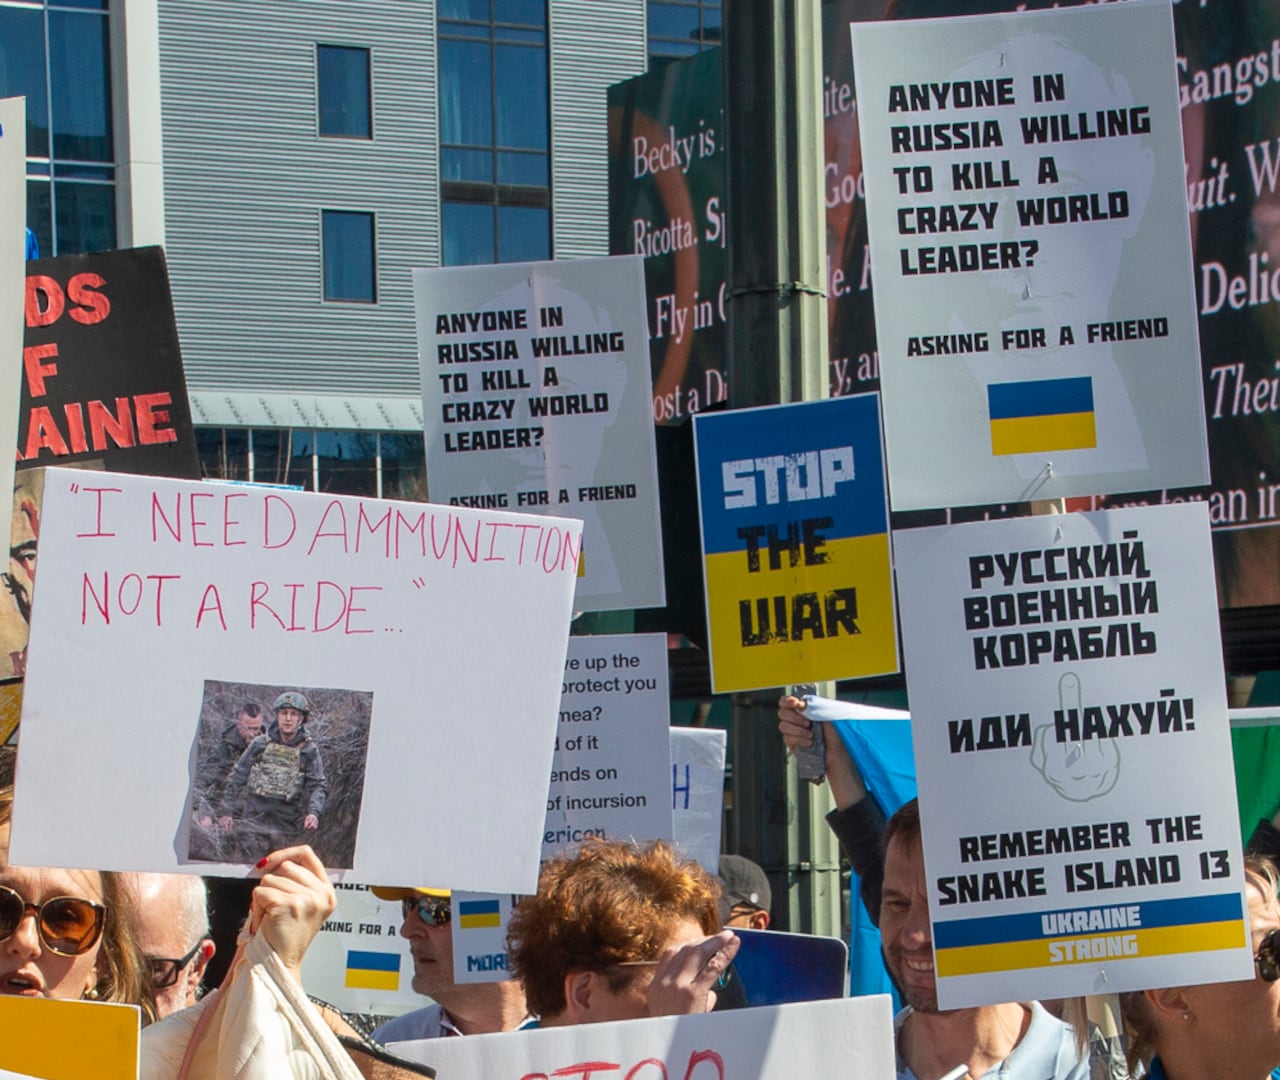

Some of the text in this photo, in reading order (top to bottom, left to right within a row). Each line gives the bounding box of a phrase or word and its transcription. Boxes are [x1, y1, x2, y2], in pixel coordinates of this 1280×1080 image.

[888, 77, 1015, 113] ANYONE
[1033, 73, 1065, 103] IN
[633, 119, 716, 179] Becky is
[890, 106, 1151, 153] RUSSIA WILLING
[893, 165, 933, 194] TO
[951, 160, 1019, 192] KILL
[1037, 156, 1058, 185] A
[897, 190, 1129, 236] CRAZY WORLD
[633, 218, 699, 258] Ricotta.
[900, 239, 1039, 276] LEADER?
[436, 306, 563, 335] ANYONE IN
[656, 291, 714, 344] Fly in
[907, 317, 1168, 357] ASKING FOR A FRIEND
[438, 331, 624, 364] RUSSIA WILLING
[439, 366, 559, 394] TO KILL A
[442, 392, 609, 423] CRAZY WORLD
[444, 427, 544, 453] LEADER?
[449, 484, 637, 508] ASKING FOR A FRIEND
[721, 446, 856, 510] STOP
[1210, 490, 1249, 524] an
[150, 492, 297, 550] NEED
[307, 500, 583, 574] AMMUNITION
[737, 516, 835, 573] THE
[969, 530, 1151, 590] РУССКИЙ
[81, 571, 182, 626] NOT
[195, 584, 228, 631] A
[739, 587, 861, 647] WAR
[585, 653, 640, 672] up the
[973, 622, 1157, 670] КОРАБЛЬ
[625, 678, 656, 694] you
[948, 688, 1195, 754] ИДИ НАХУЙ!
[565, 735, 599, 751] of it
[596, 768, 617, 780] on
[566, 793, 647, 810] incursion
[959, 815, 1203, 863] REMEMBER THE
[936, 849, 1231, 905] SNAKE ISLAND 13
[359, 923, 396, 936] FOR A
[1041, 905, 1141, 935] UKRAINE
[1048, 934, 1138, 963] STRONG
